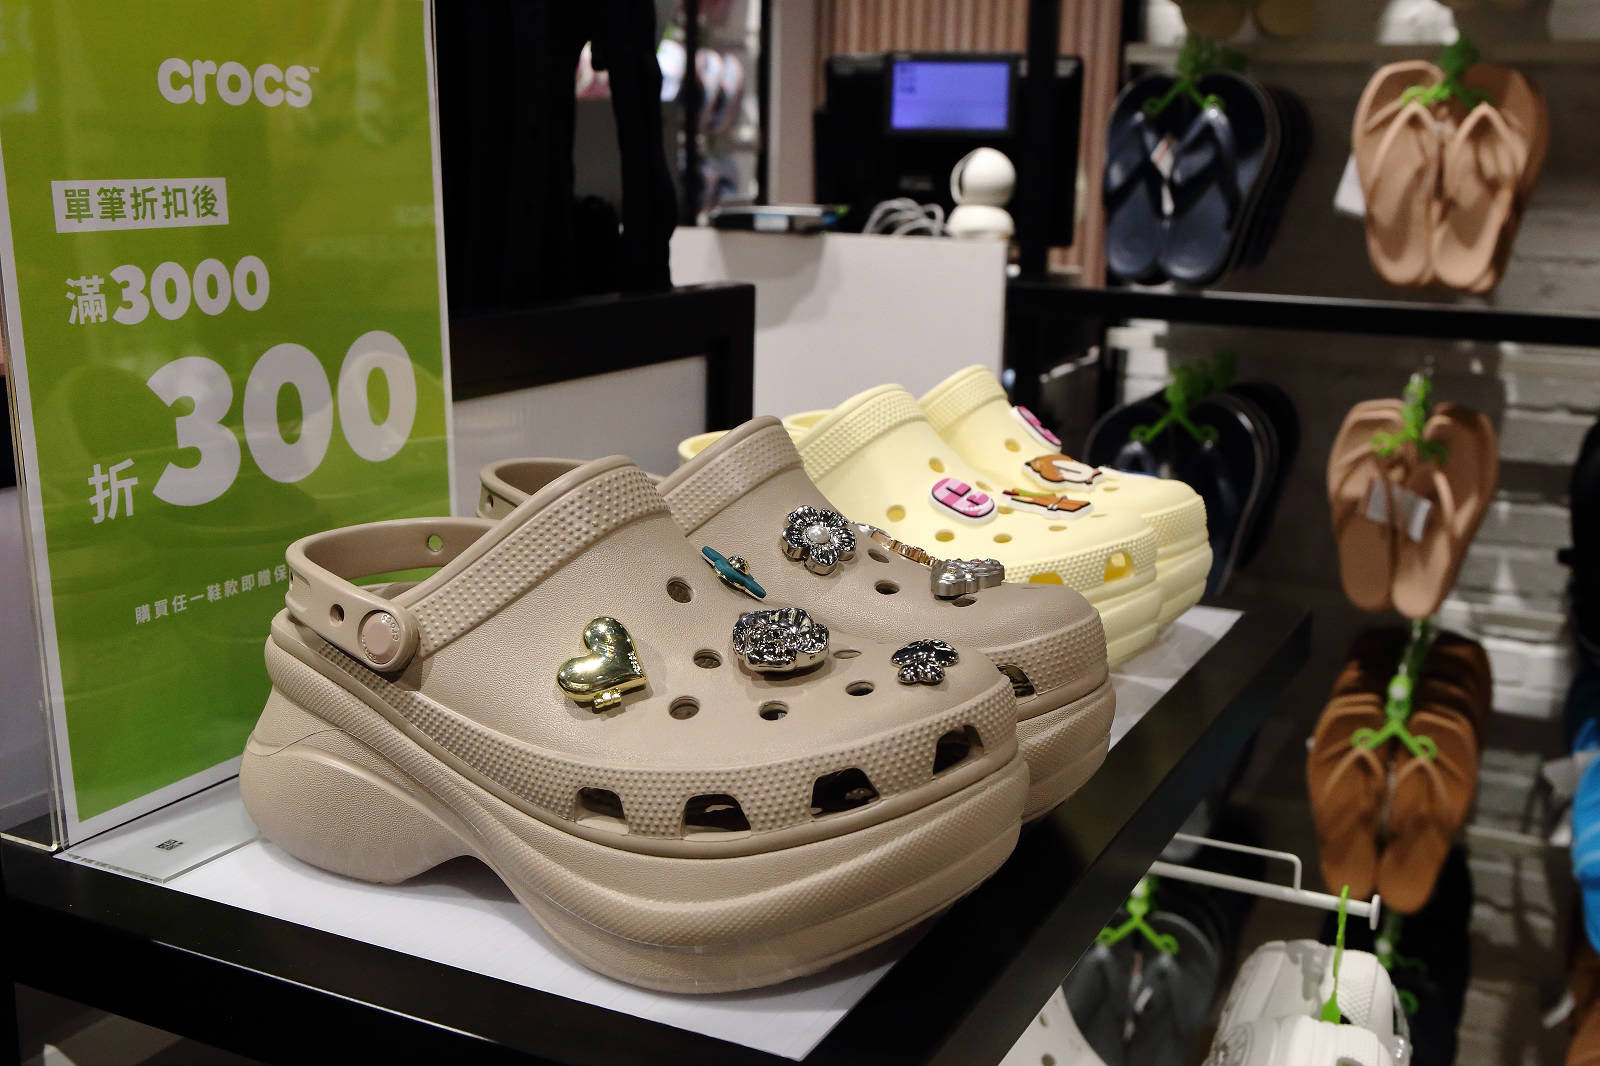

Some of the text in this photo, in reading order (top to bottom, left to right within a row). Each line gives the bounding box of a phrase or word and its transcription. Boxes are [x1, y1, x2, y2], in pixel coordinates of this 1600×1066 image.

[63, 184, 219, 224] 單筆折扣後
